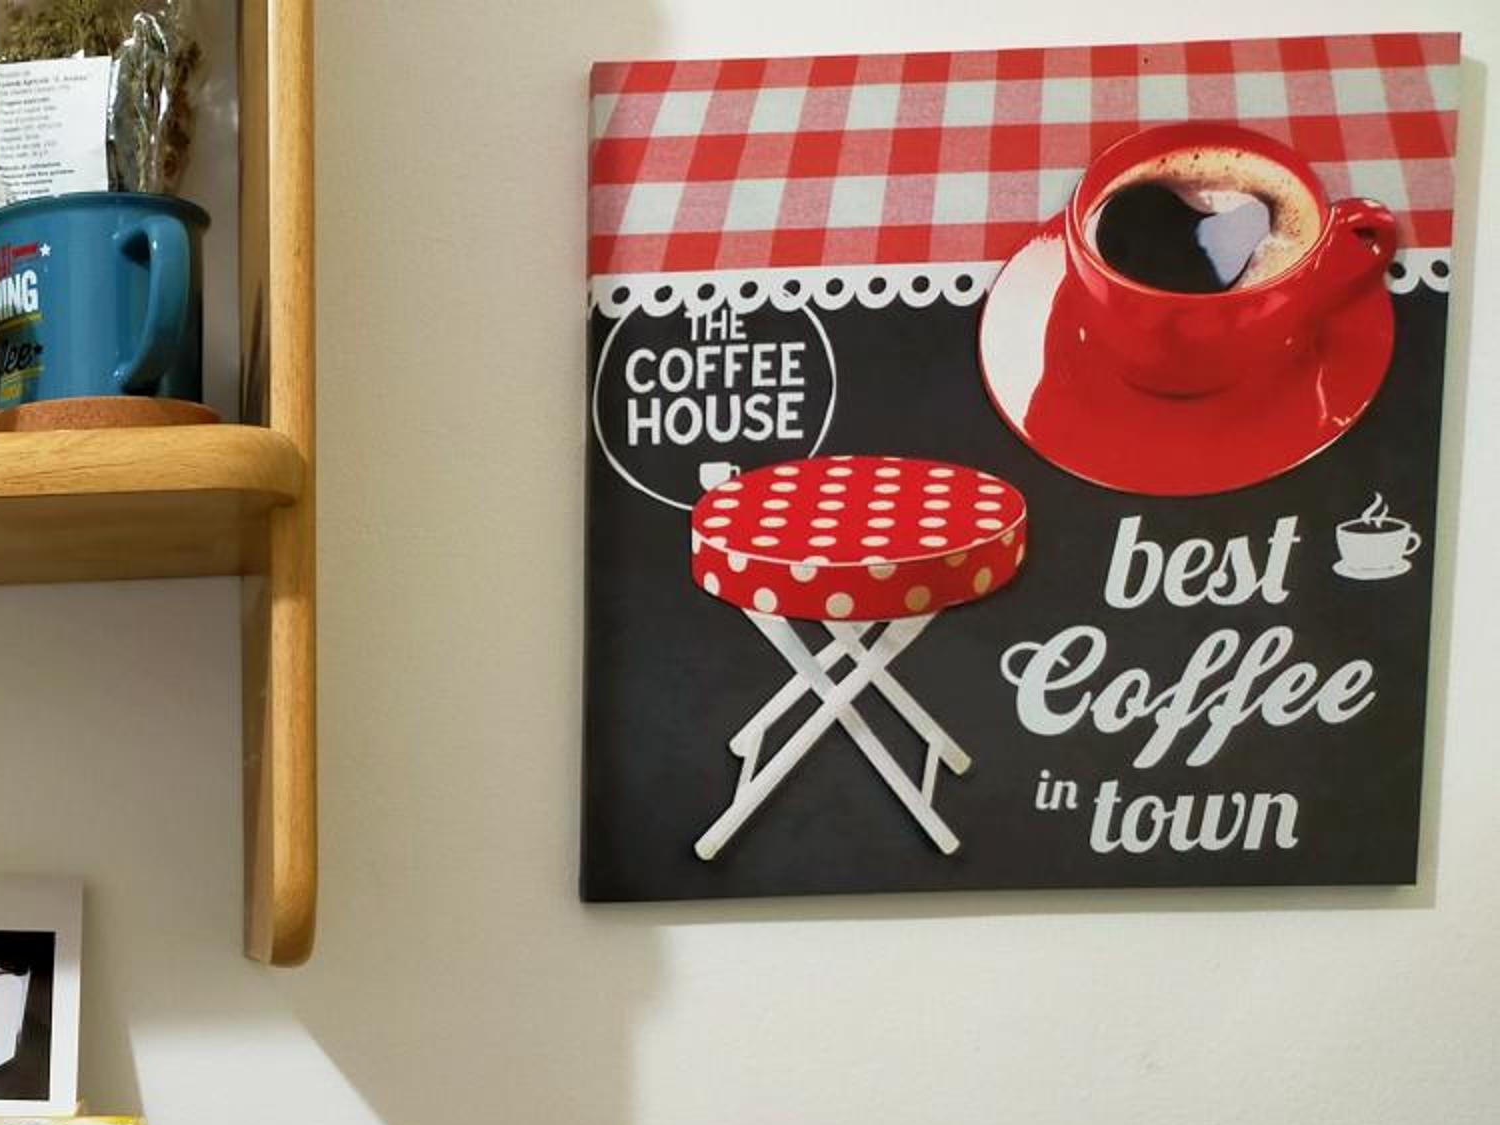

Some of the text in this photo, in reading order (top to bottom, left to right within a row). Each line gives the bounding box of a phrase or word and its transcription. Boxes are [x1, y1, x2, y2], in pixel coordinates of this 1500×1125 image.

[684, 307, 747, 341] THE
[625, 343, 805, 393] COFFEE
[627, 392, 805, 446] HOUSE
[1104, 515, 1300, 608] best
[1000, 625, 1376, 769] Coffee
[1035, 770, 1298, 853] in town
